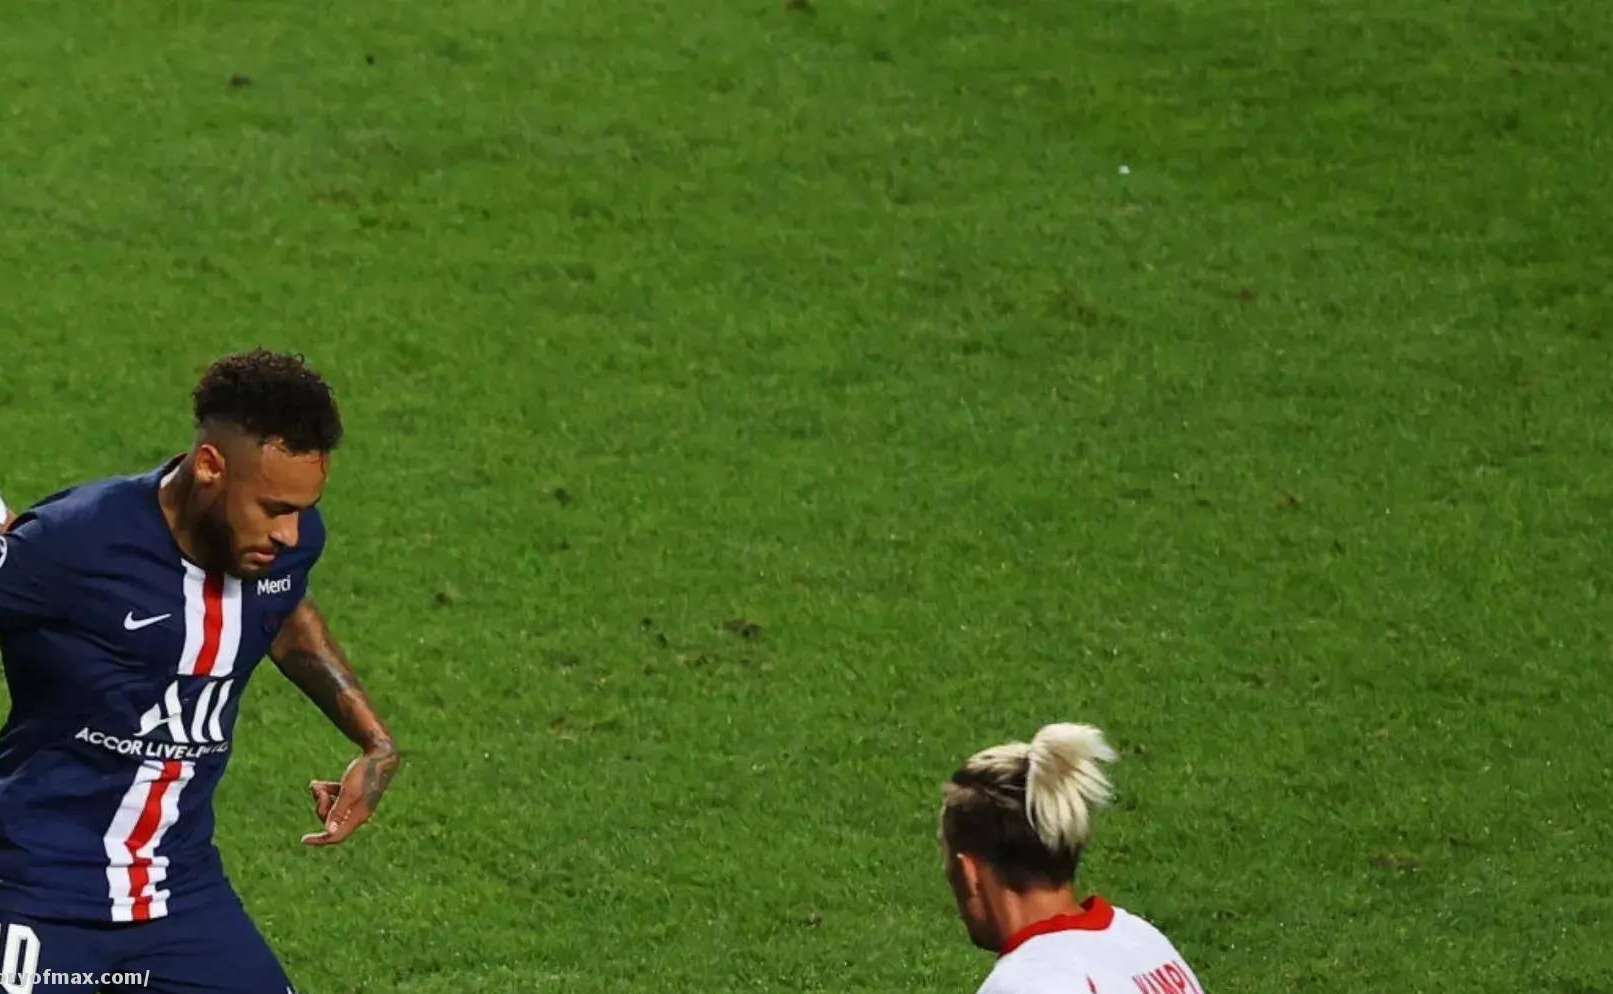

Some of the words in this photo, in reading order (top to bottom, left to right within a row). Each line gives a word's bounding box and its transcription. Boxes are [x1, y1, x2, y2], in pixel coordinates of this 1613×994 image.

[256, 574, 292, 596] Merci
[74, 727, 143, 757] ACCOR
[145, 742, 188, 760] LIVE
